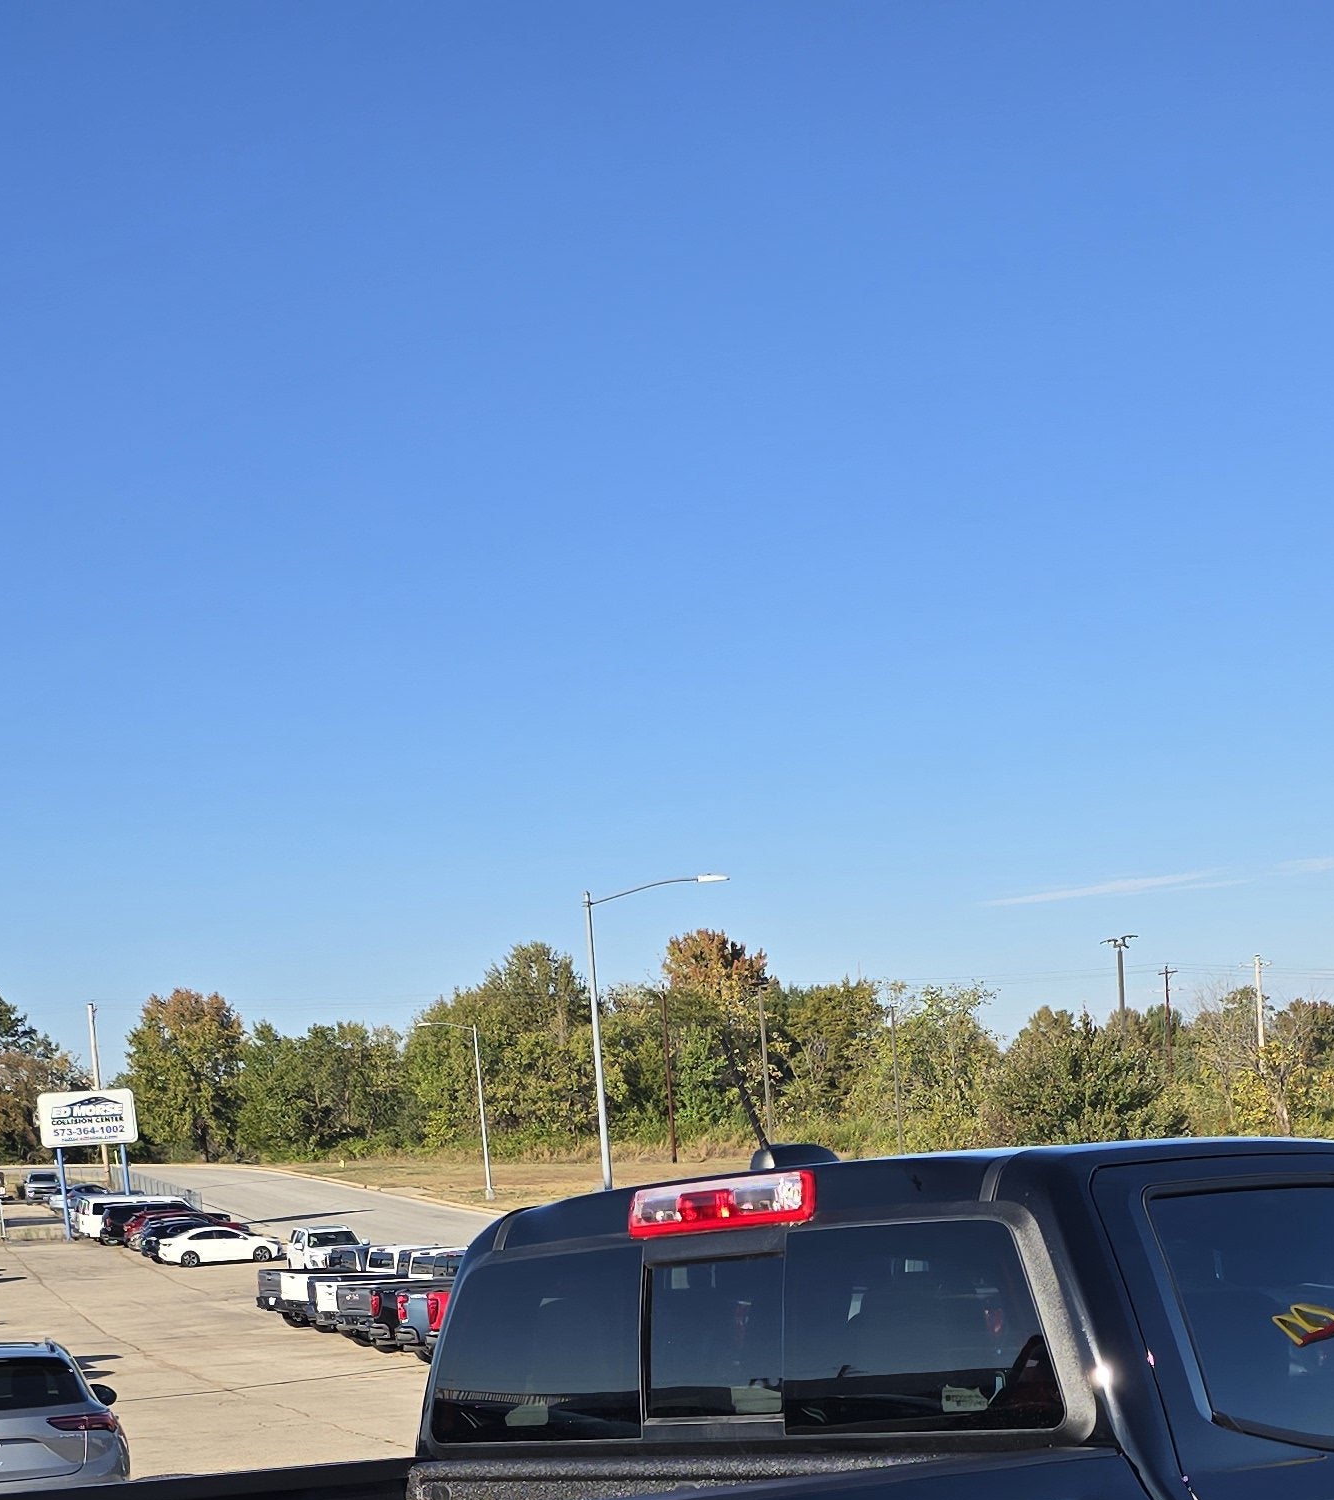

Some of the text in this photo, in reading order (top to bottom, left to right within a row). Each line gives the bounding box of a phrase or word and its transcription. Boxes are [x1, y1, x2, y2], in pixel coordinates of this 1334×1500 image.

[51, 1103, 123, 1119] ED MORSE
[51, 1115, 124, 1126] COLLISION CENTER
[54, 1125, 125, 1137] 573-364-1002
